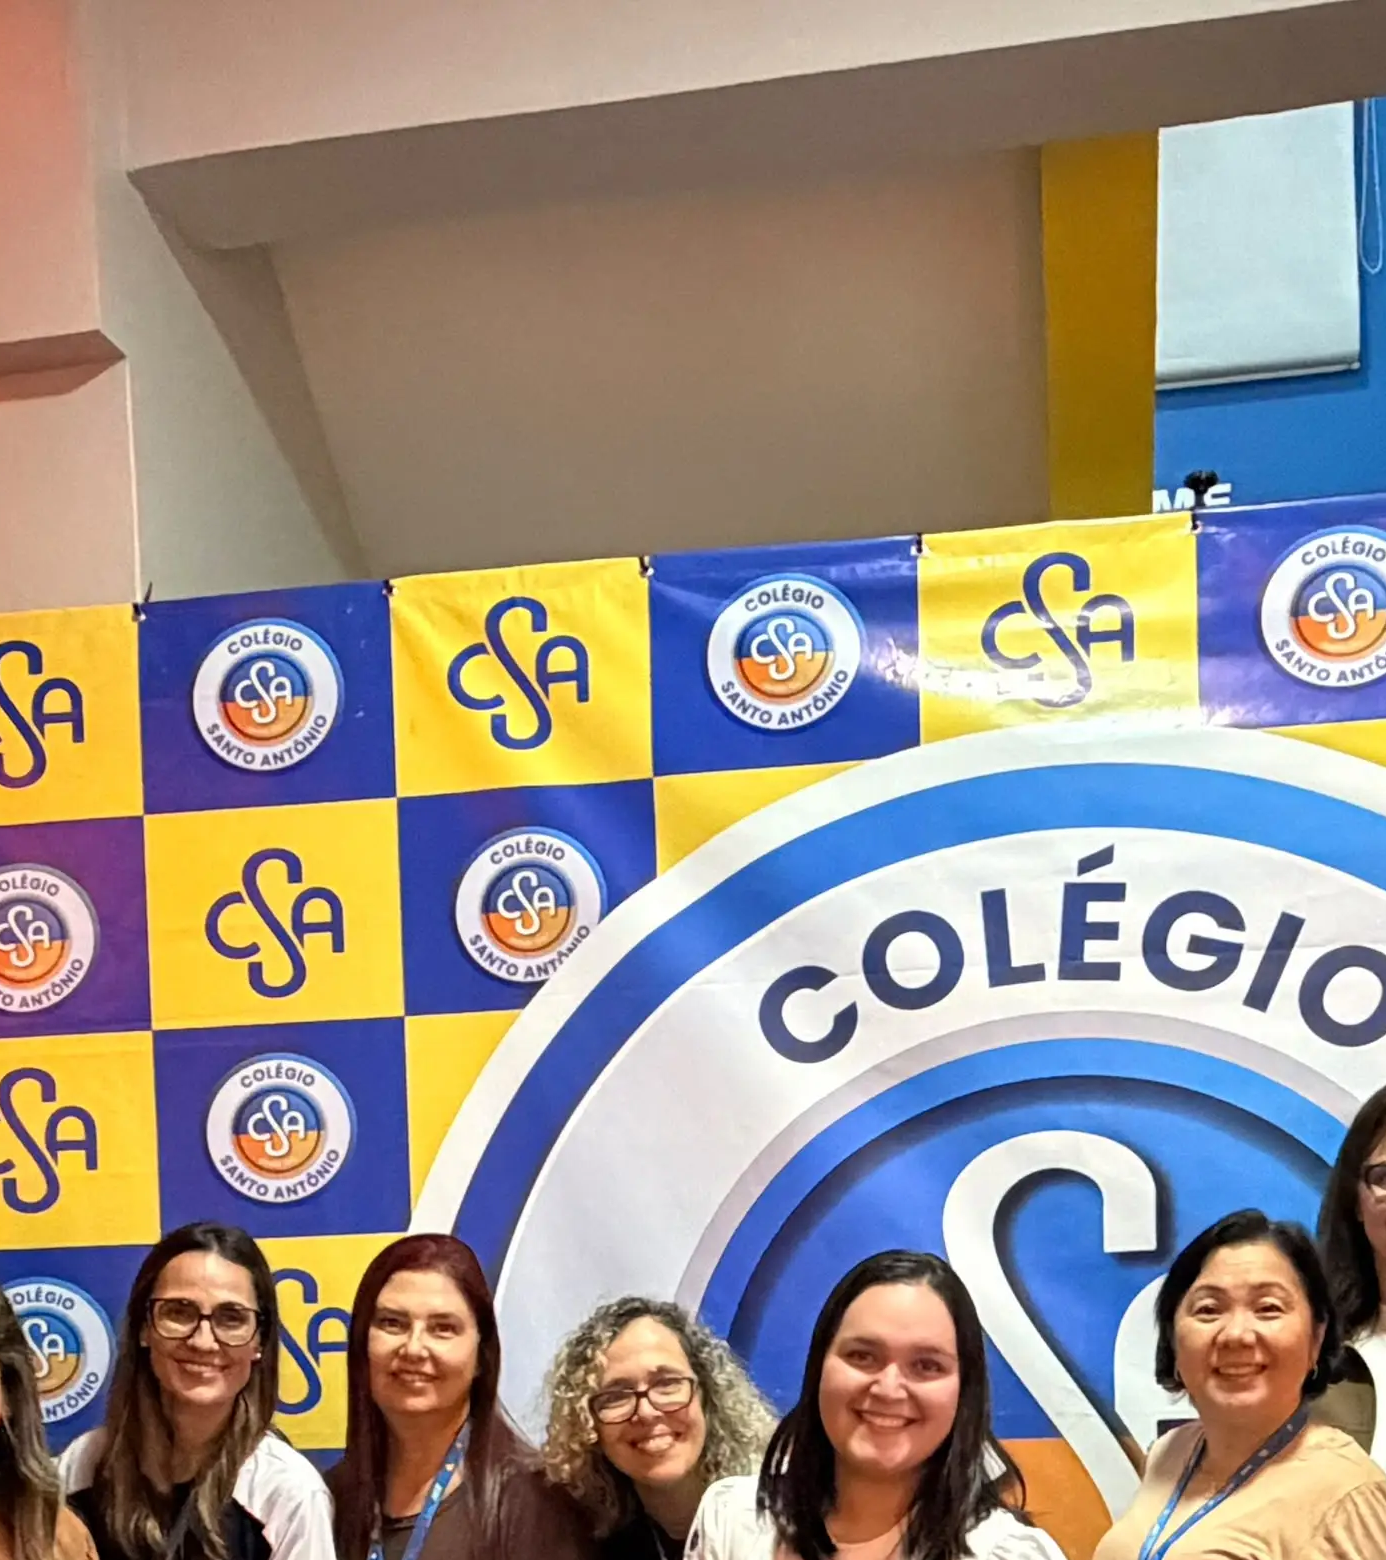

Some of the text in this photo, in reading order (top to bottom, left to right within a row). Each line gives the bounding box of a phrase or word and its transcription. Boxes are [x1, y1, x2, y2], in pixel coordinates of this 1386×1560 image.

[1301, 536, 1386, 565] COLÉGIO
[744, 584, 824, 611] COLÉGIO
[227, 628, 303, 655] COLÉGIO
[981, 552, 1135, 708] CSA
[447, 597, 590, 750] CSA
[1275, 638, 1330, 682] SANTO
[721, 669, 848, 726] SANTO ANTÔNIO
[206, 714, 327, 767] SANTO ANTÔNIO
[490, 837, 565, 865] COLÉGIO
[205, 848, 345, 998] CSA
[469, 934, 519, 977] SANTO
[18, 958, 85, 1009] ANTÔNIO
[240, 1063, 316, 1088] COLÉGIO
[219, 1149, 340, 1200] SANTO ANTÔNIO
[13, 1287, 75, 1311] OLÉGIO
[22, 1318, 65, 1378] SA
[271, 1268, 352, 1415] SA
[45, 1371, 99, 1420] NTÔNIO
